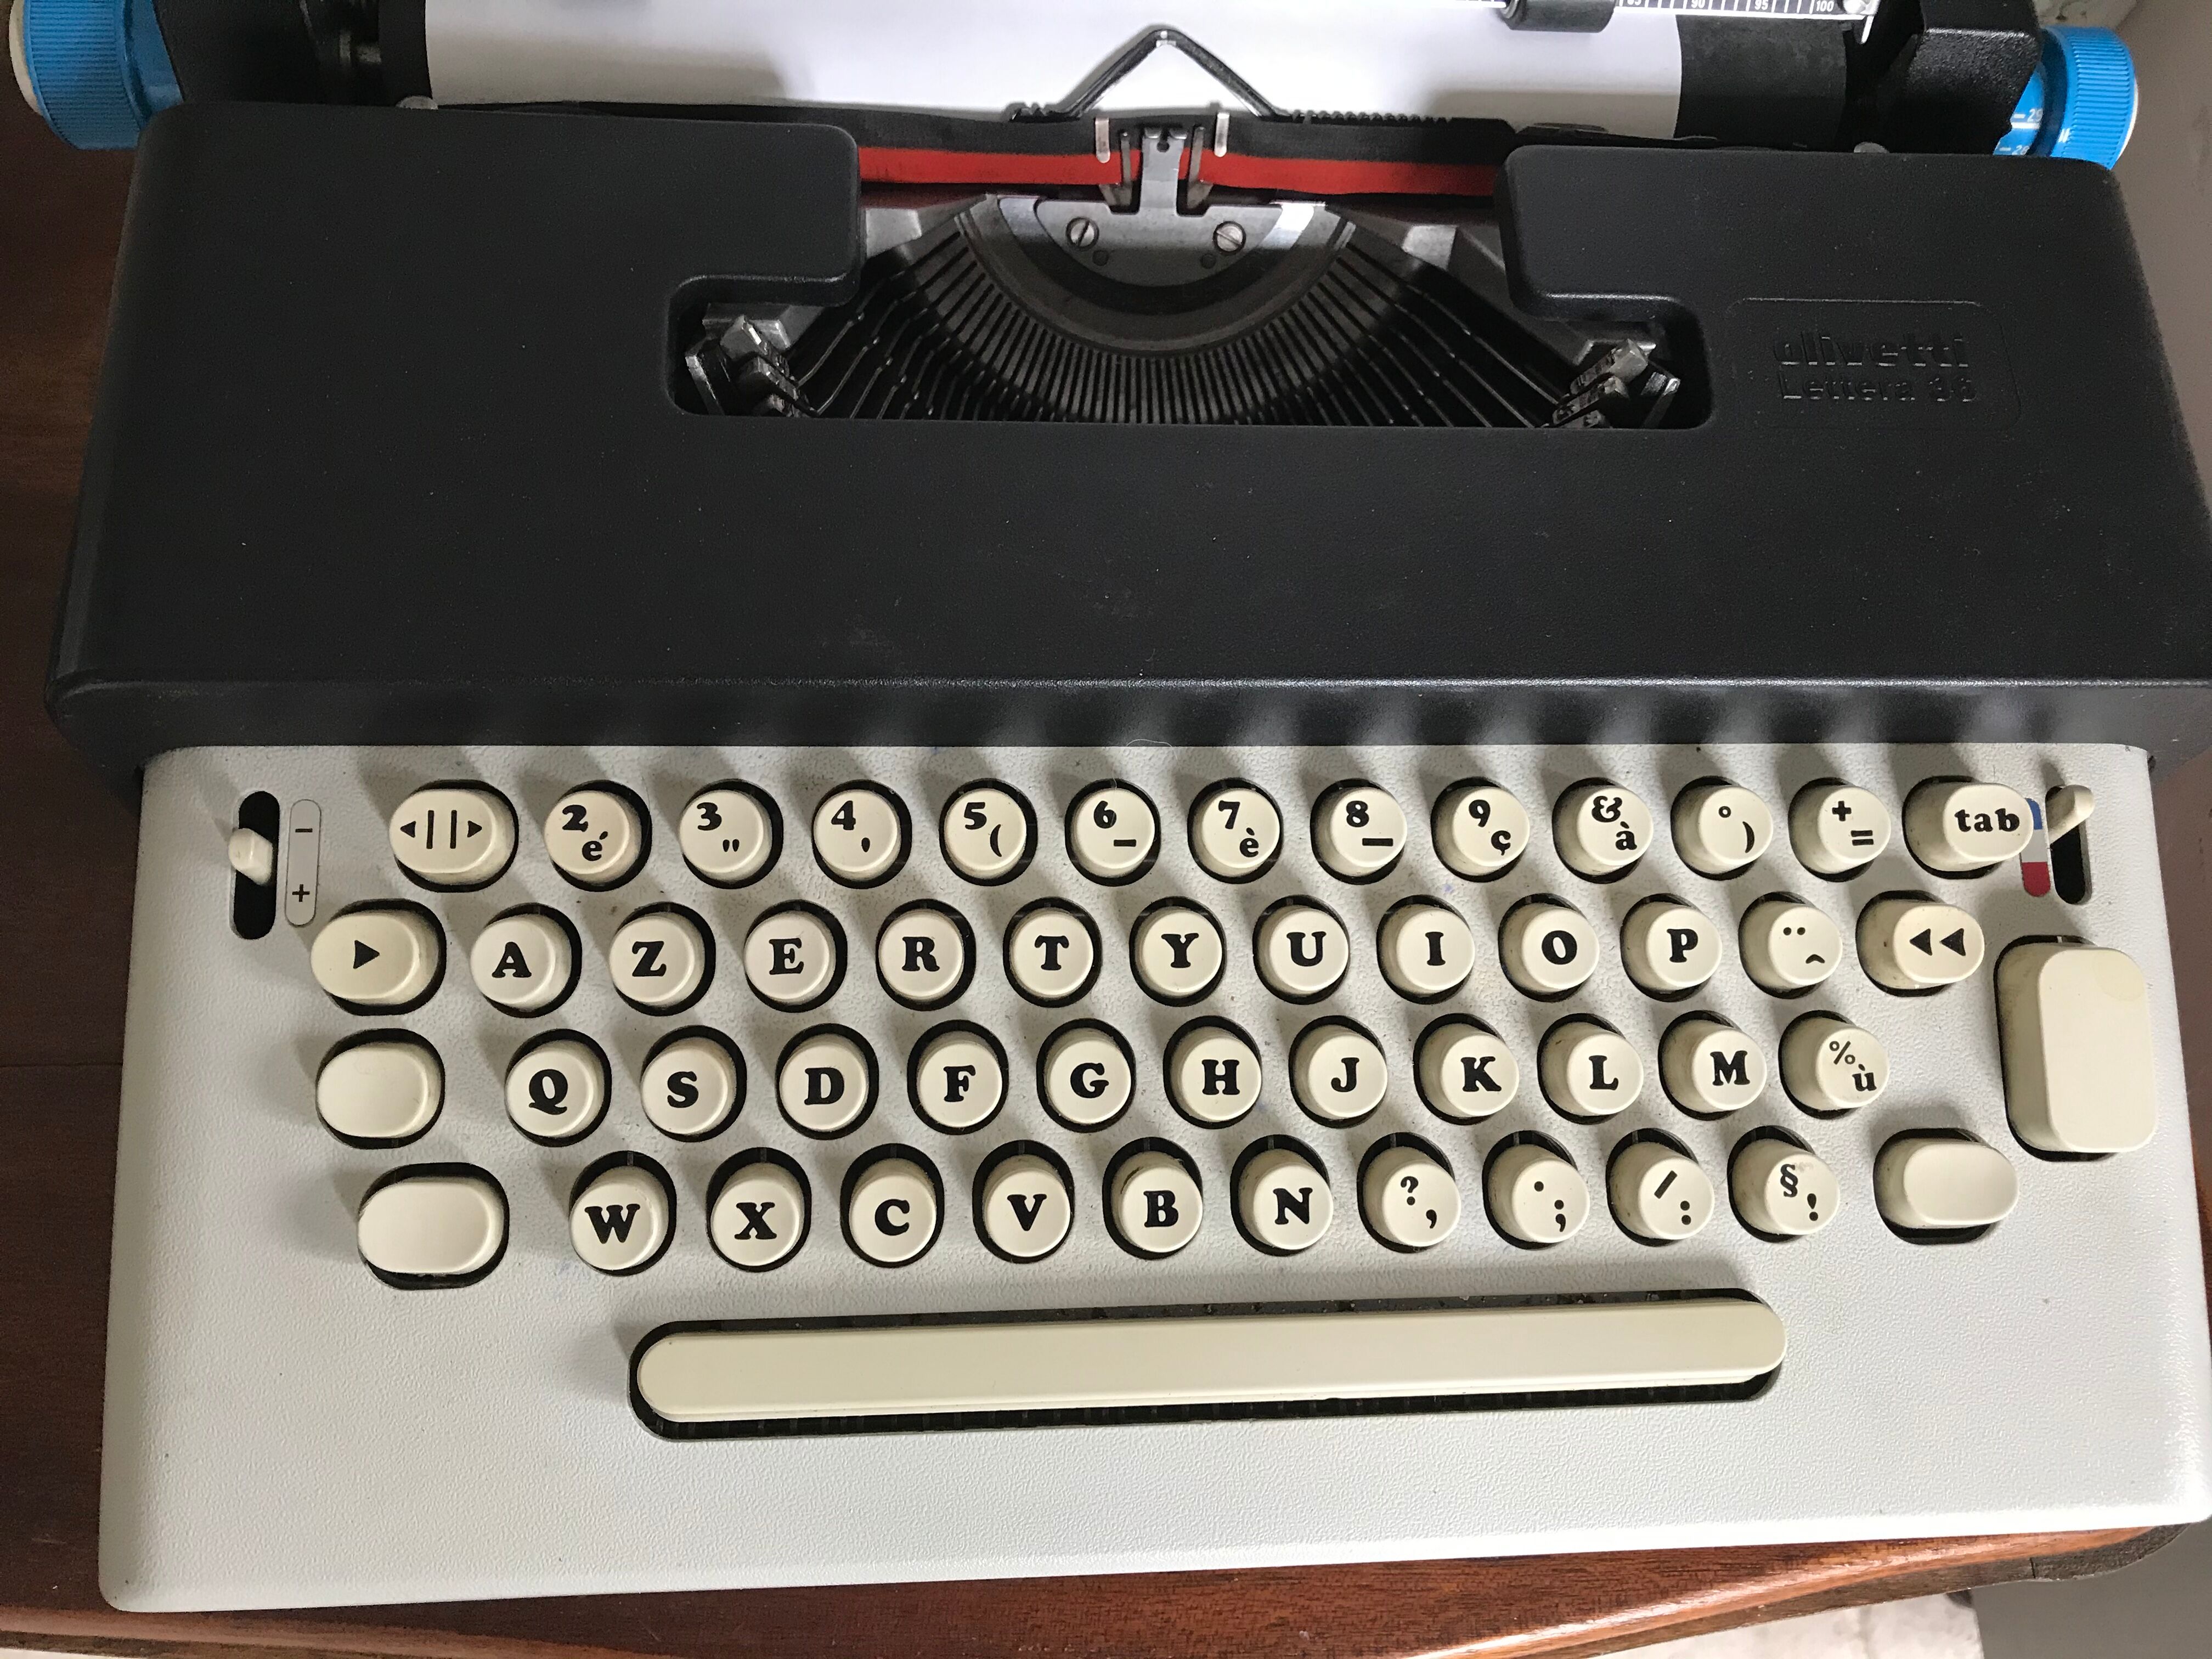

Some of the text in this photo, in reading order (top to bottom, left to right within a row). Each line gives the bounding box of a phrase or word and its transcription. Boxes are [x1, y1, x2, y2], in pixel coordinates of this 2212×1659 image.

[1816, 0, 1834, 12] 100
[562, 805, 588, 832] 2
[697, 803, 721, 831] 3
[831, 801, 856, 830] 4
[964, 802, 987, 830] 5
[1093, 800, 1117, 829] 6
[1218, 800, 1240, 829] 7
[1346, 800, 1369, 828] 8
[1469, 799, 1491, 827] 9
[1592, 795, 1622, 823] &
[1832, 800, 1852, 822] +
[1954, 808, 2020, 832] tab
[582, 831, 608, 861] é
[990, 824, 1002, 857] (
[1239, 827, 1259, 857] è
[1491, 830, 1511, 856] ç
[1615, 822, 1638, 850] à
[1742, 821, 1755, 853] )
[1850, 830, 1874, 846] =
[291, 884, 311, 902] +
[492, 941, 532, 978] A
[631, 940, 667, 977] Z
[769, 938, 804, 975] E
[901, 936, 940, 972] R
[1034, 935, 1069, 971] T
[1161, 933, 1199, 968] Y
[1286, 931, 1327, 967] U
[1425, 932, 1446, 966] I
[1542, 930, 1577, 965] O
[1667, 928, 1699, 963] P
[1710, 1050, 1750, 1086] M
[1829, 1040, 1855, 1065] %
[667, 1071, 699, 1108] S
[804, 1067, 845, 1105] D
[943, 1065, 976, 1103] F
[1070, 1062, 1109, 1099] G
[1201, 1059, 1240, 1096] H
[1331, 1057, 1359, 1093] J
[1460, 1056, 1502, 1092] K
[1589, 1055, 1619, 1091] L
[1852, 1064, 1877, 1092] ù
[528, 1069, 568, 1115] Q
[1400, 1176, 1419, 1206] ?
[1654, 1170, 1677, 1199] /
[1780, 1164, 1798, 1198] §
[734, 1201, 777, 1240] X
[874, 1199, 910, 1236] C
[1007, 1193, 1047, 1232] V
[1143, 1190, 1179, 1228] B
[1273, 1187, 1313, 1225] N
[1554, 1200, 1566, 1232] ;
[1680, 1200, 1691, 1225] :
[1807, 1193, 1818, 1221] !
[584, 1203, 641, 1244] W
